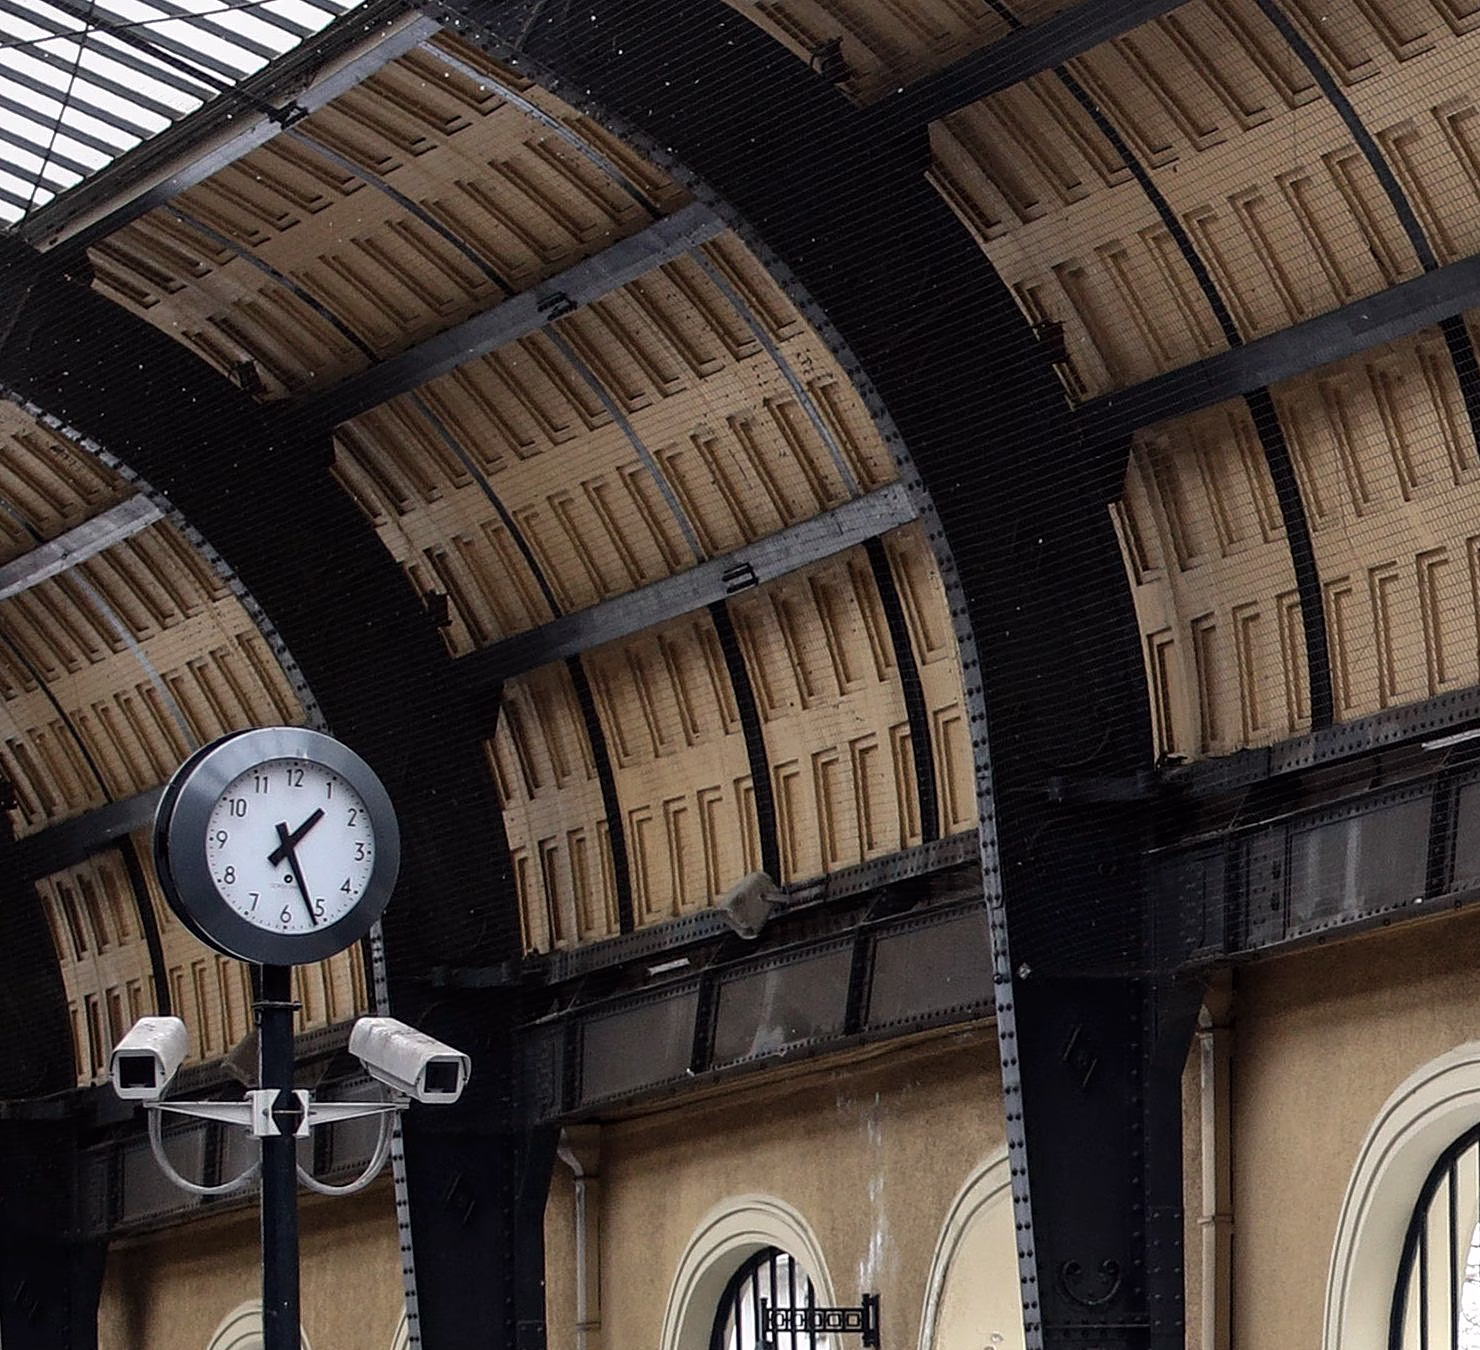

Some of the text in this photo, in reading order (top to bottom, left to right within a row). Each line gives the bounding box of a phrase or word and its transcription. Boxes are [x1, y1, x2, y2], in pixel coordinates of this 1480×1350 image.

[254, 776, 268, 794] 11
[286, 769, 304, 787] 12
[326, 782, 332, 799] 1
[229, 799, 247, 817] 10
[348, 808, 357, 826] 2
[216, 830, 228, 849] 9
[354, 842, 365, 861] 3
[224, 866, 235, 884] 8
[340, 877, 351, 894] 4
[249, 893, 259, 911] 7
[315, 899, 325, 917] 5
[280, 905, 291, 923] 6
